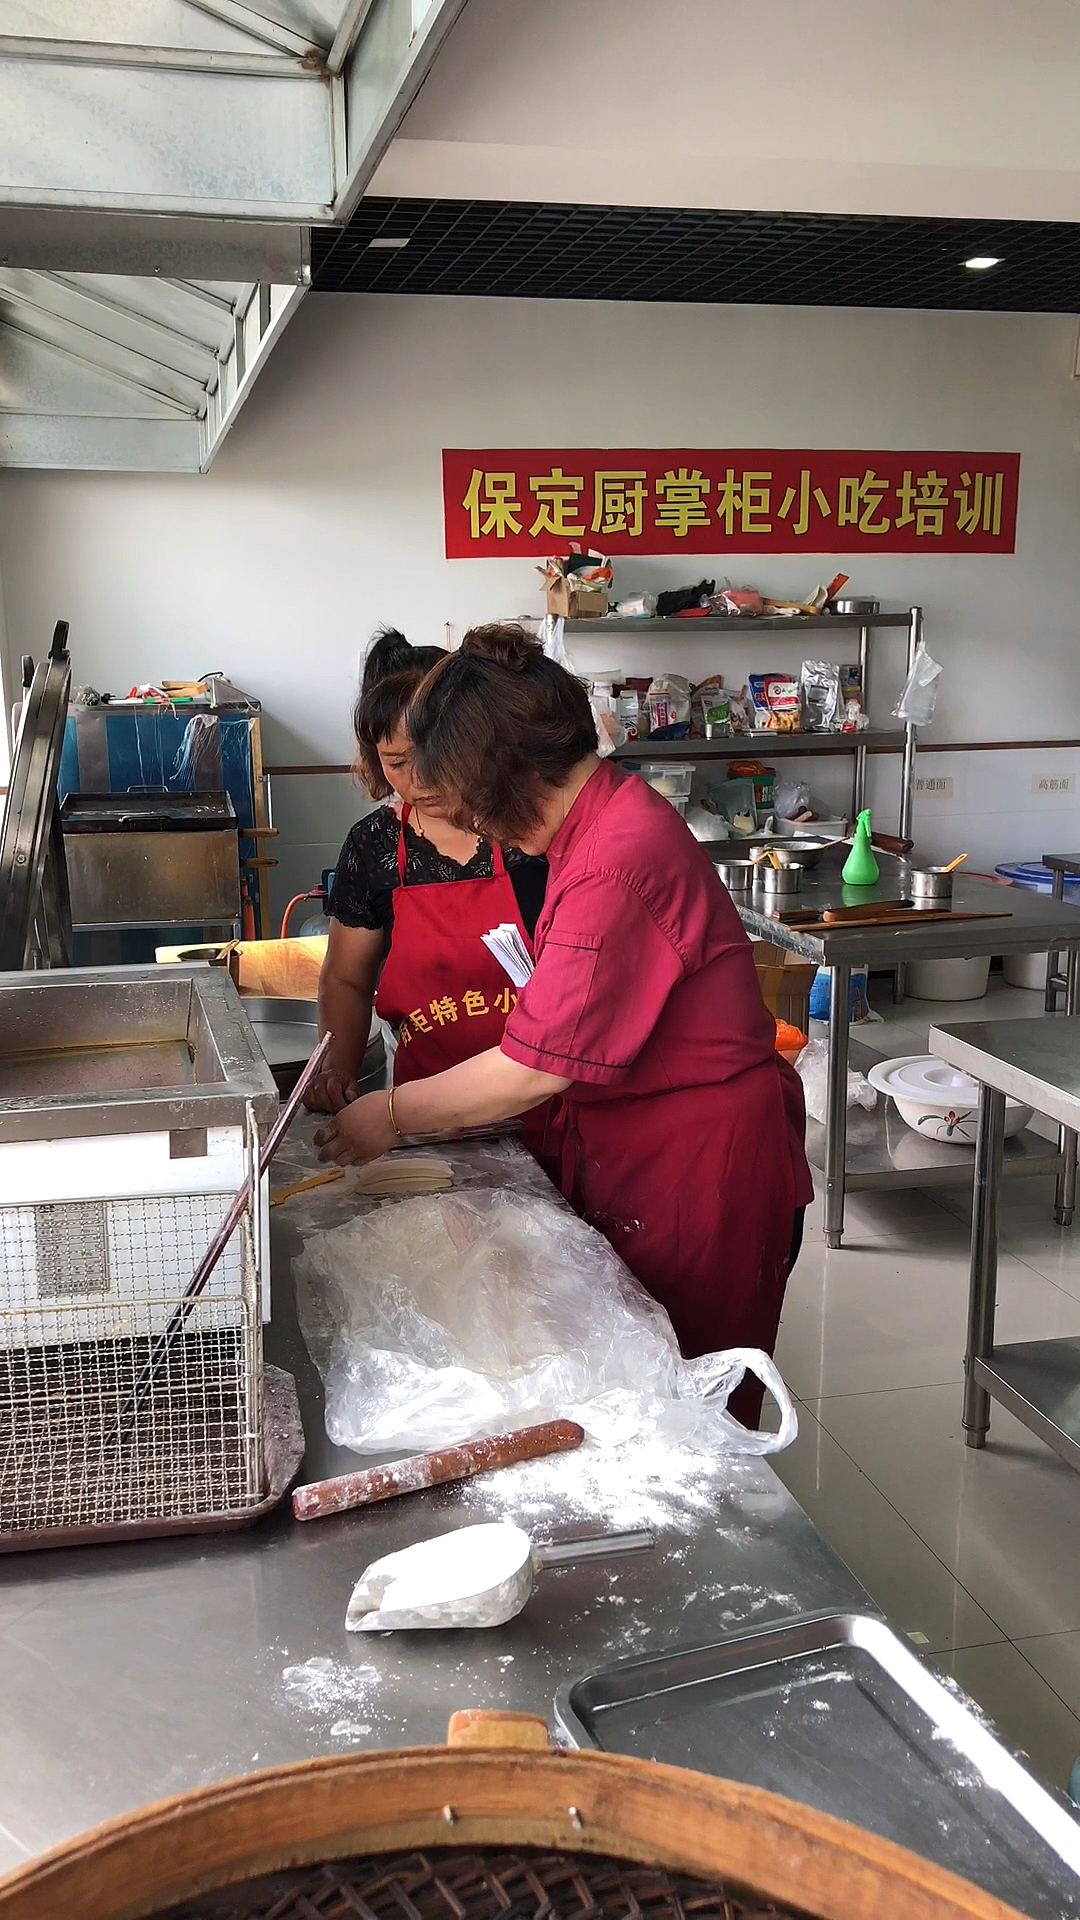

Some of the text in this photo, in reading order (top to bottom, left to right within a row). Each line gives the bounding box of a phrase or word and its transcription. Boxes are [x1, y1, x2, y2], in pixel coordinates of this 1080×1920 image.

[462, 468, 1005, 539] 保定厨掌柜小吃培训
